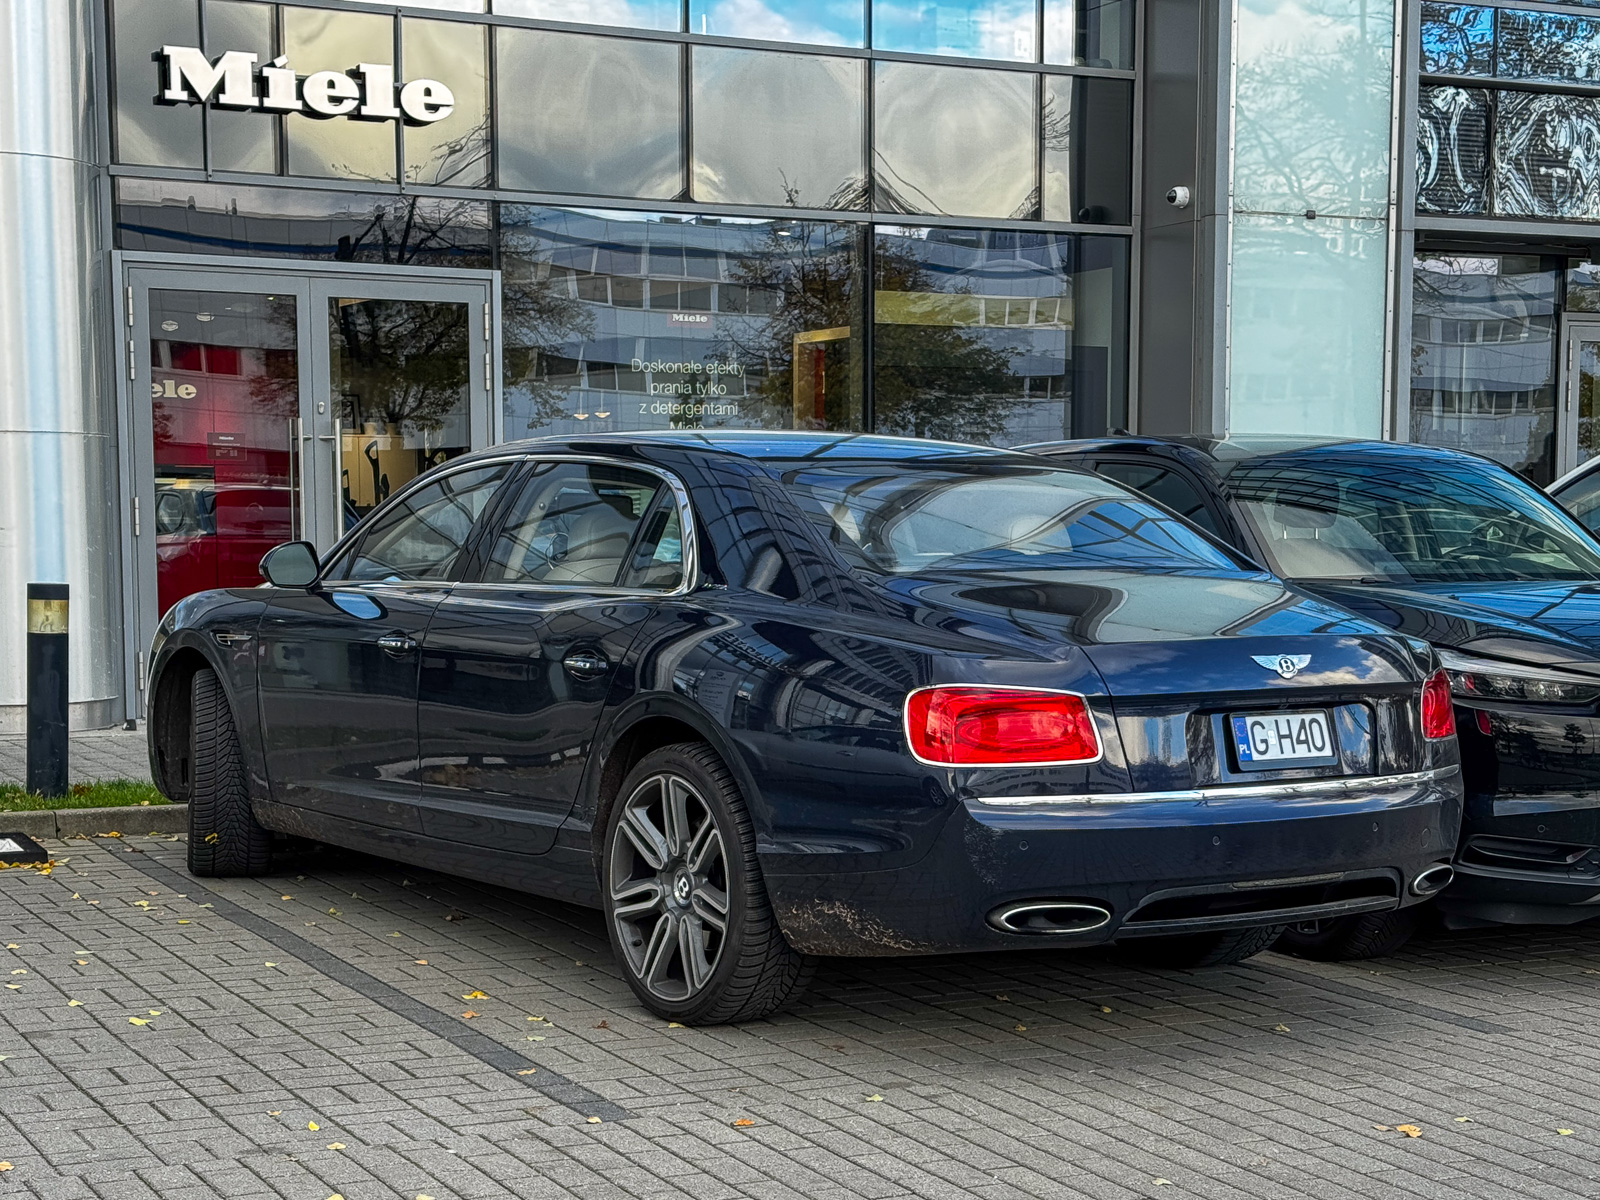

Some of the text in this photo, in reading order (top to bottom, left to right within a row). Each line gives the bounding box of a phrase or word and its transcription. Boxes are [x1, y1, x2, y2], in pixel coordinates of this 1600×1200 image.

[162, 45, 454, 122] Miele
[672, 314, 708, 322] Miele
[631, 358, 746, 378] Doskonałe efekty
[650, 380, 727, 398] prania tylko
[639, 400, 738, 418] z detergentami
[1239, 744, 1250, 754] PL
